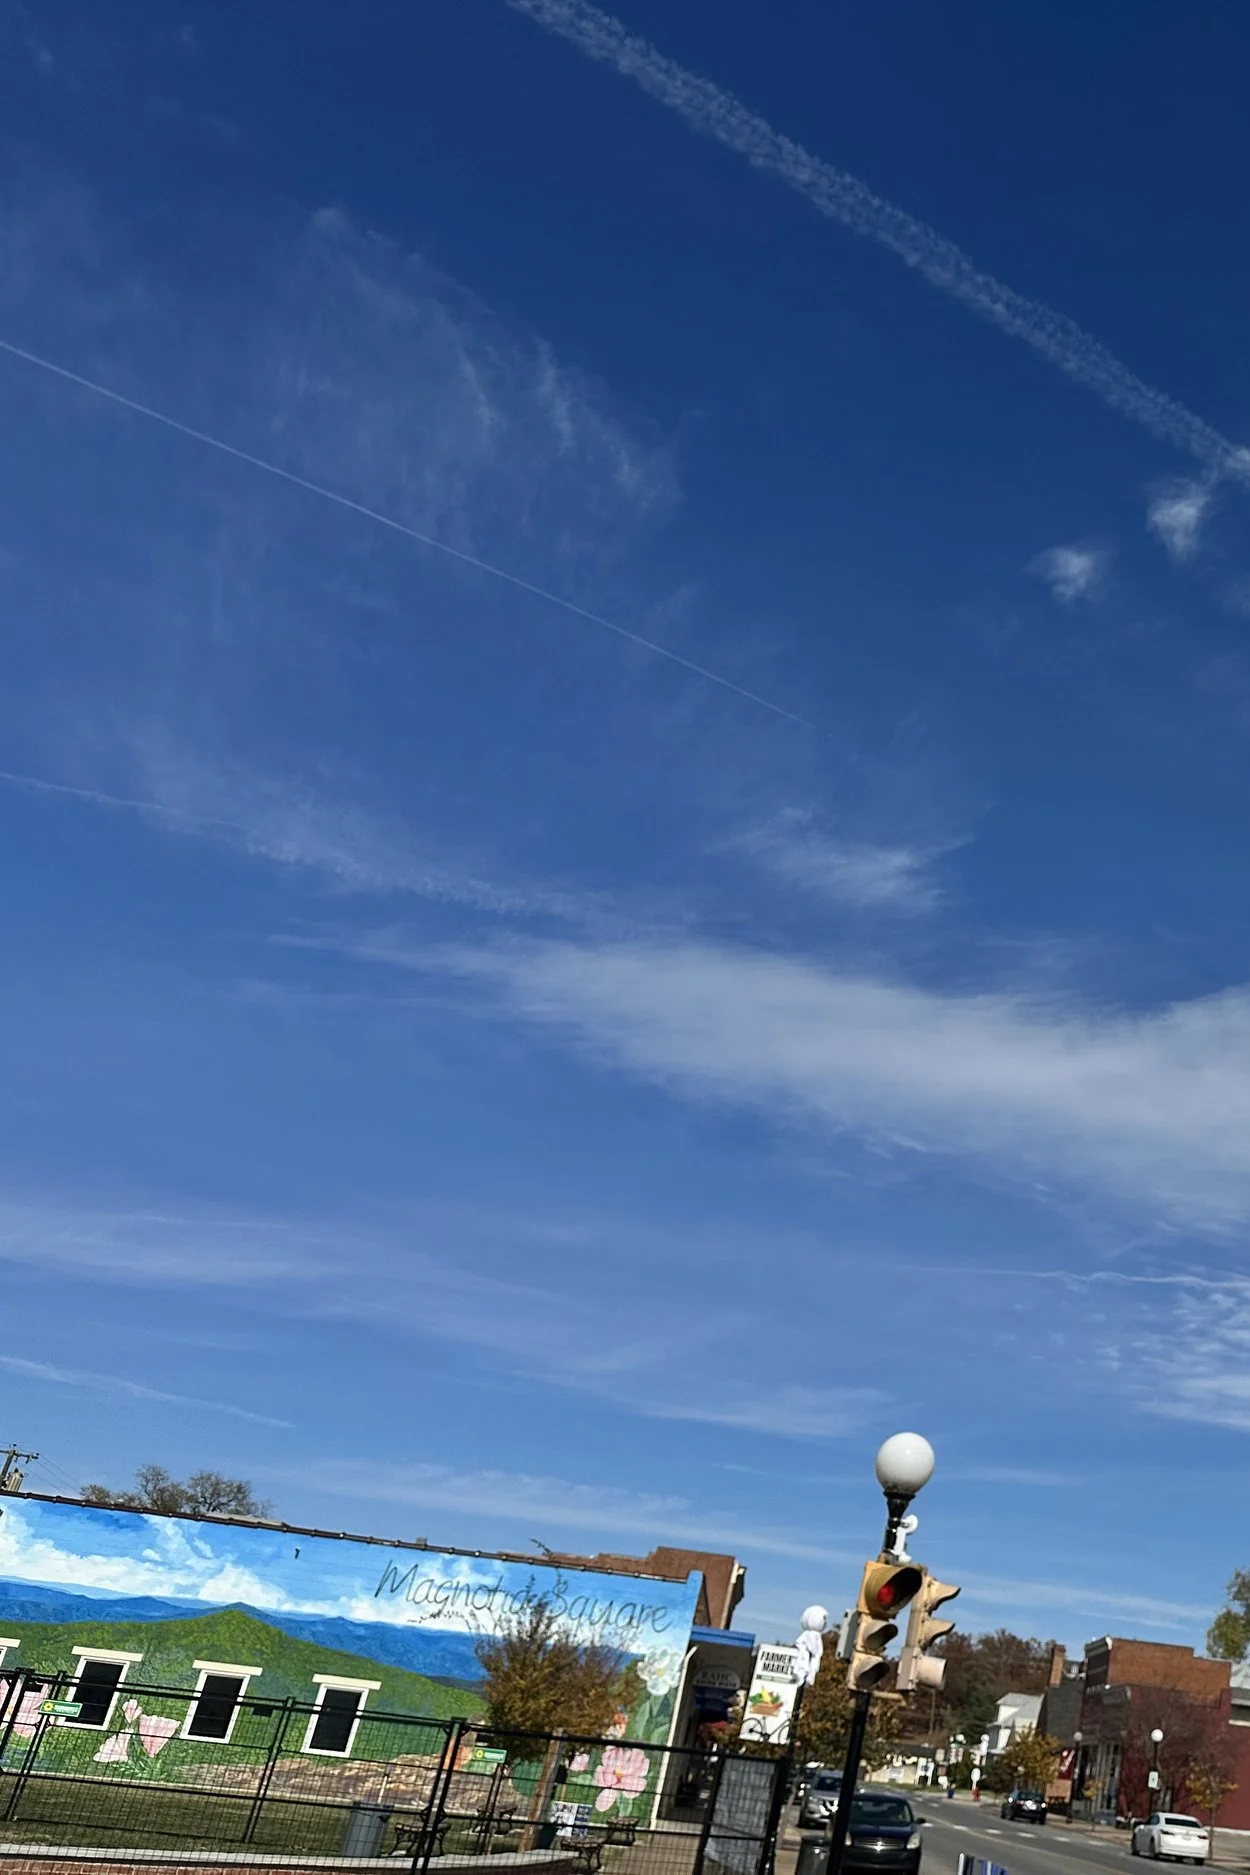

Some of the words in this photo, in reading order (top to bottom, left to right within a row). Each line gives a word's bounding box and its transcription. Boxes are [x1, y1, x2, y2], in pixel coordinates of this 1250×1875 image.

[374, 1559, 531, 1614] Magnolia
[549, 1579, 673, 1636] Square
[760, 1650, 798, 1664] FARMER
